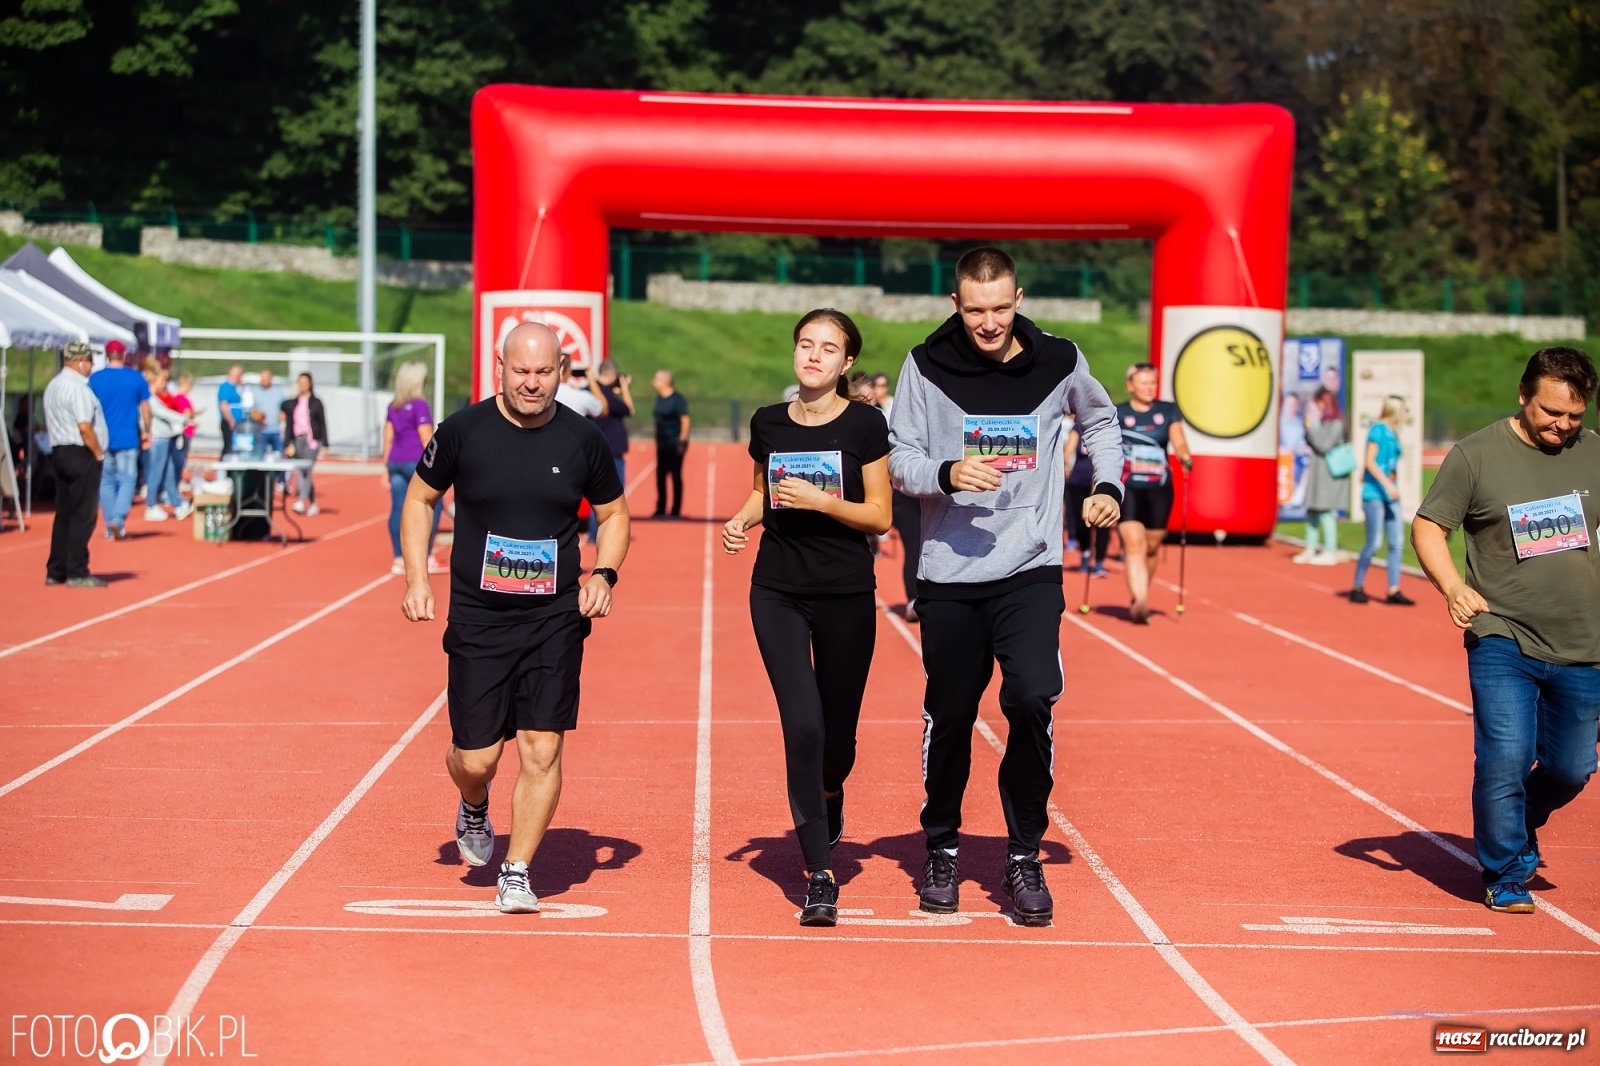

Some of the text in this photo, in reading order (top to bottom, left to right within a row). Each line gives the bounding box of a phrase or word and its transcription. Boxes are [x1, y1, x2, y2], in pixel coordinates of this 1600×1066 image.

[979, 434, 1023, 456] 021
[1527, 514, 1571, 541] 030
[498, 556, 543, 580] 009
